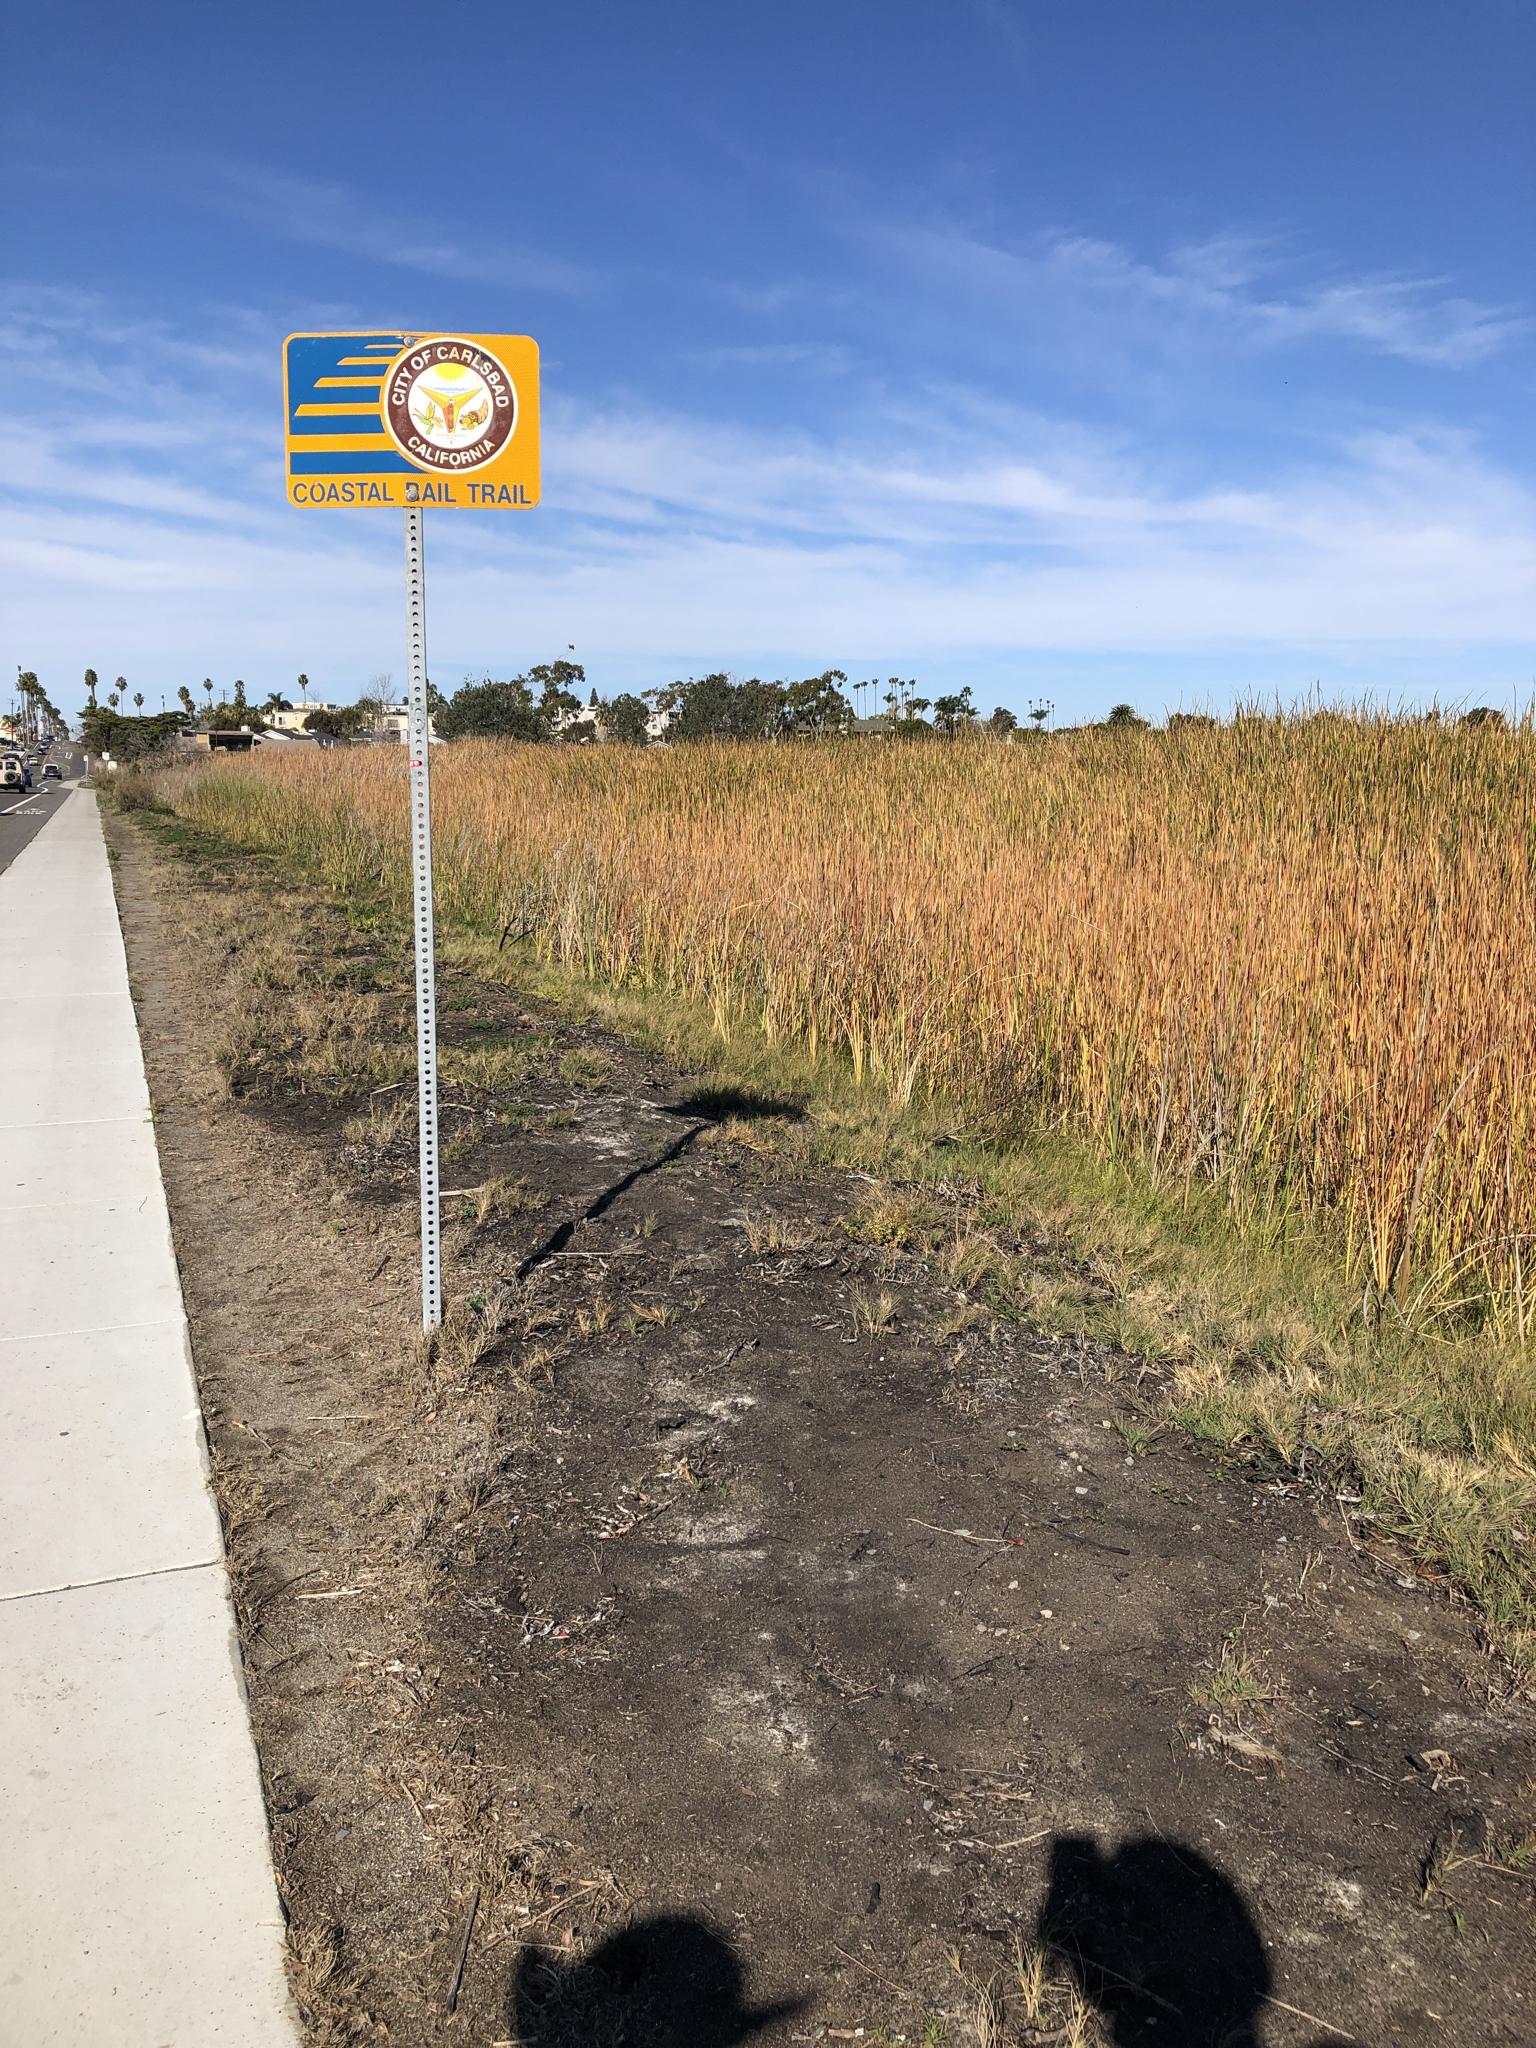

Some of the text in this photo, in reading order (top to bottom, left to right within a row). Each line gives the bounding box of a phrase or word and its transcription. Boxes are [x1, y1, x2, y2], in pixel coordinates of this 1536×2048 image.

[391, 346, 510, 408] CITY OF CARLSBAD
[407, 435, 495, 466] CALIFORNIA
[292, 482, 394, 504] COASTAL
[466, 483, 532, 505] TRAIL
